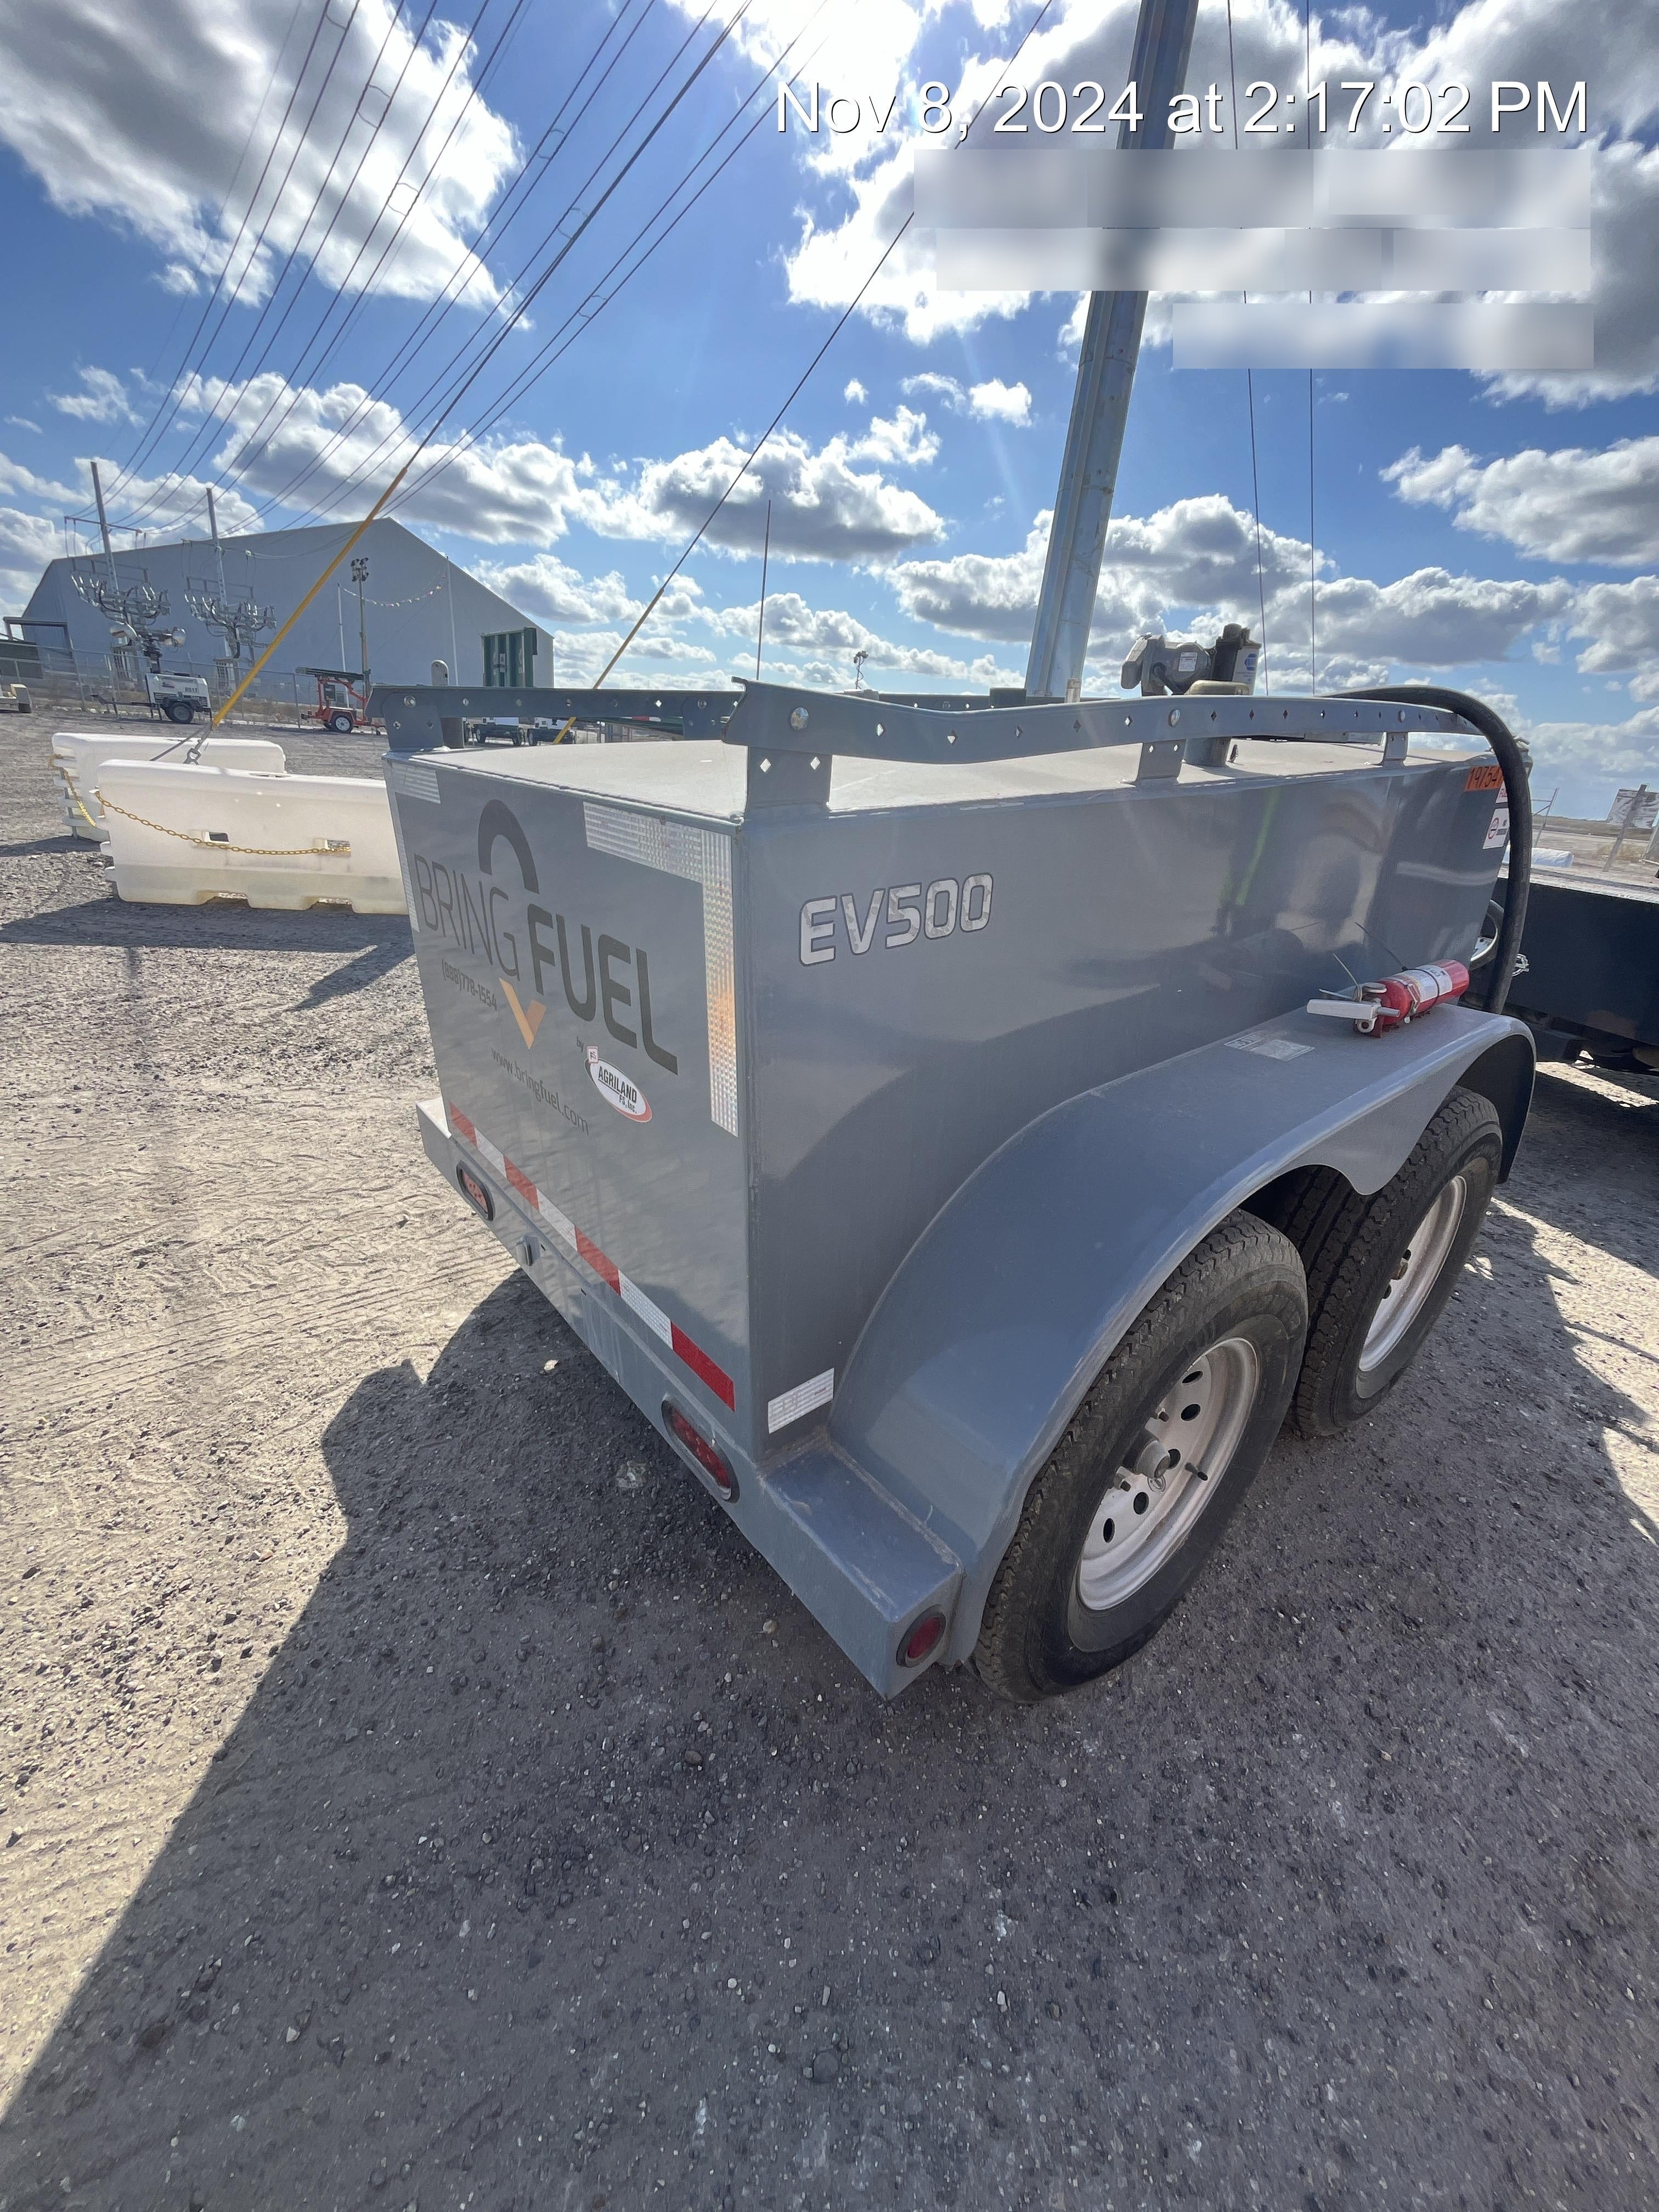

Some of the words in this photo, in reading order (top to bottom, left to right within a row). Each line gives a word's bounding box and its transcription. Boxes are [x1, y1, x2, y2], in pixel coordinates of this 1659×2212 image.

[799, 872, 993, 967] EV500
[414, 852, 521, 982] BRING
[527, 902, 679, 1076] FUEL
[442, 958, 498, 1012] (888)778-1554
[576, 1035, 585, 1053] by
[490, 1047, 589, 1137] www.bringfuel.com
[598, 1065, 637, 1103] AGRILAND
